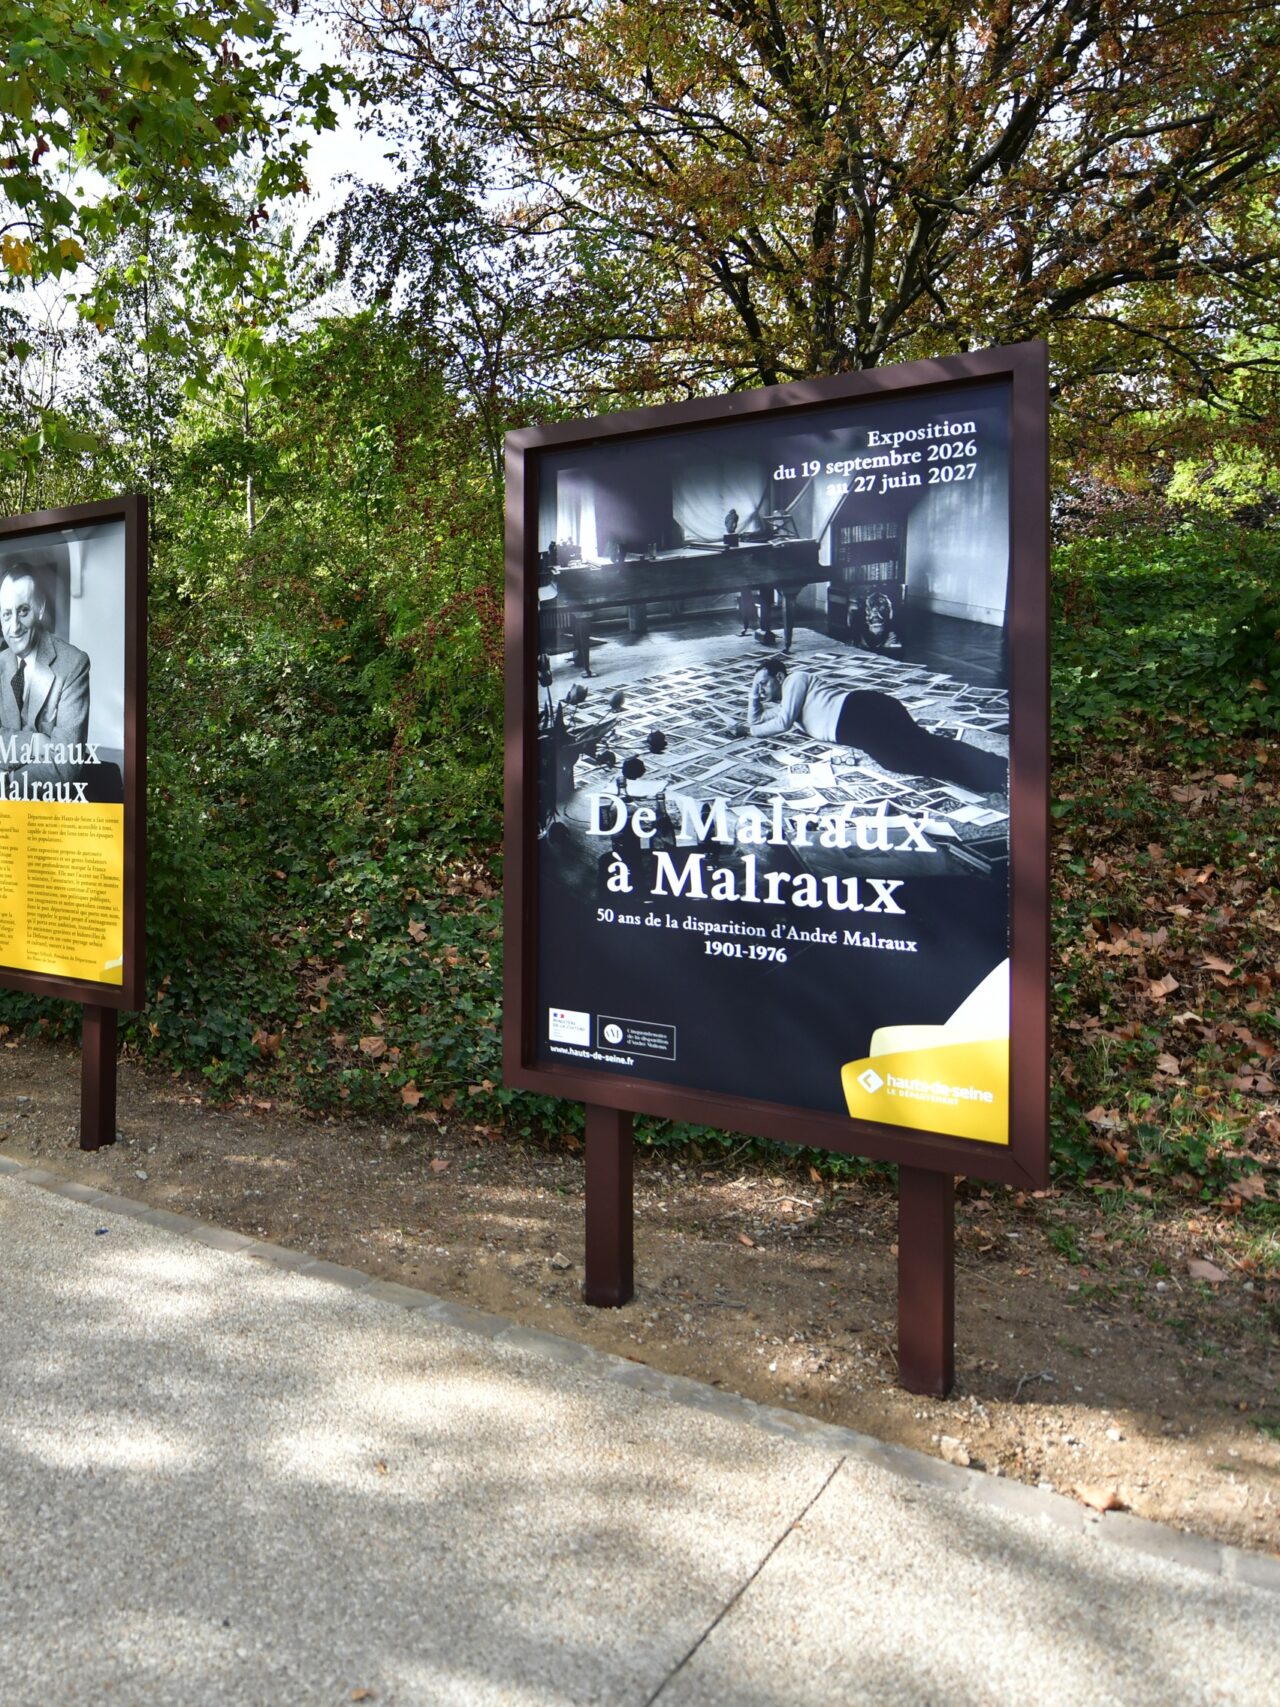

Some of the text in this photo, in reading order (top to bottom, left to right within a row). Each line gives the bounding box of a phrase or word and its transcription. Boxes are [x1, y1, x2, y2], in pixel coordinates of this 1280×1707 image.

[867, 420, 976, 449] Exposition
[773, 439, 977, 482] du 19 septembre 2026
[826, 462, 977, 497] au 27 juin 2027
[584, 794, 937, 853] De Malraux
[605, 851, 906, 915] à Malraux
[596, 907, 918, 953] 50 ans de la disparition d'André Malraux
[703, 940, 787, 963] 1901-1976
[550, 1045, 635, 1066] www.hauts-de-seine.fr
[886, 1073, 993, 1103] hauts-de-seine
